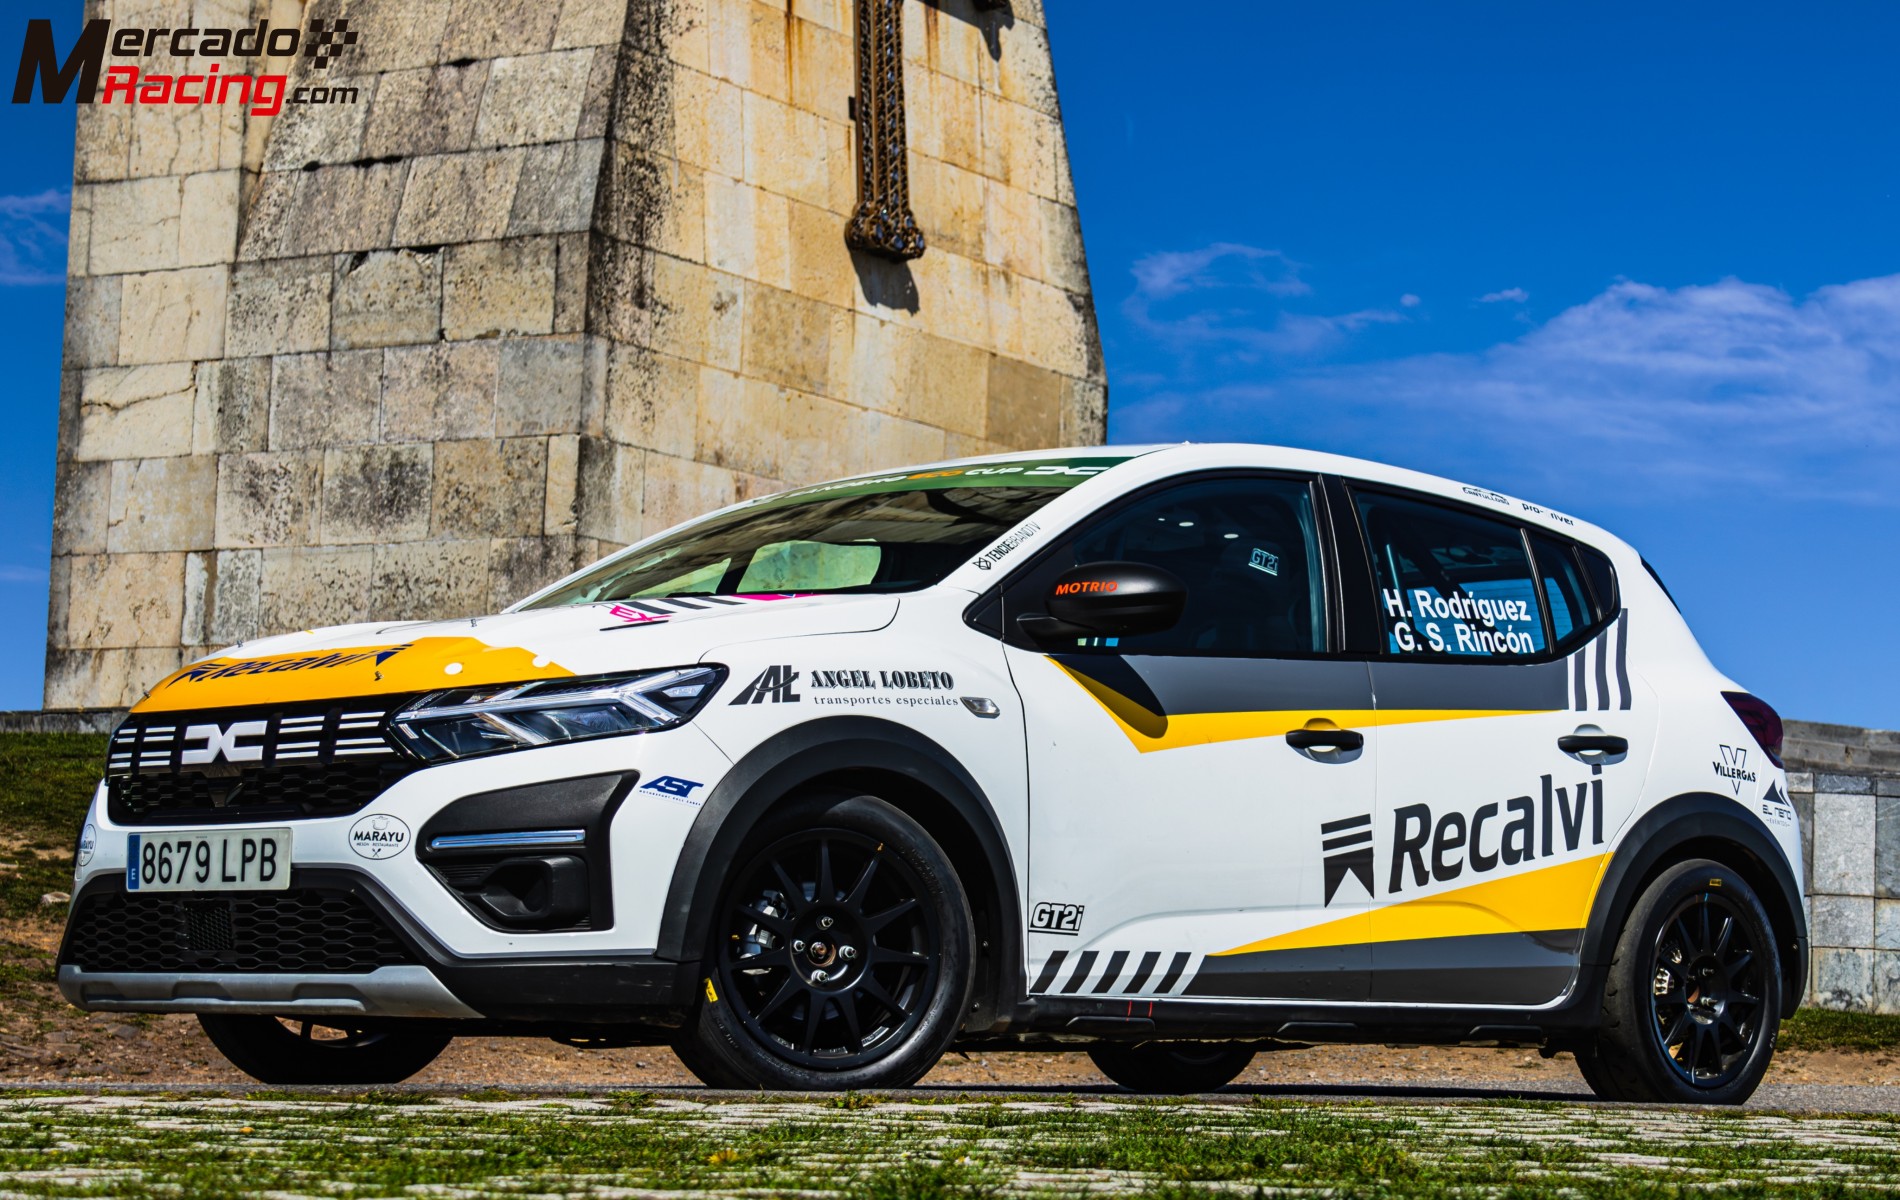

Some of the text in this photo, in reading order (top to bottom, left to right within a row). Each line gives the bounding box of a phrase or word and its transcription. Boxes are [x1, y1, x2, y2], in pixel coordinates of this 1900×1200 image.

[1055, 580, 1119, 596] MOTRIO
[1382, 588, 1532, 627] H. Rodríguez
[1393, 621, 1536, 654] G. S. Rincón
[810, 670, 955, 691] ANGEL LOBETO
[813, 694, 959, 707] transportes especiales
[353, 830, 405, 843] MARAYU
[1387, 763, 1606, 895] Recalvi
[142, 840, 211, 885] 8679
[221, 837, 277, 883] LPB
[1029, 901, 1086, 932] GT2i
